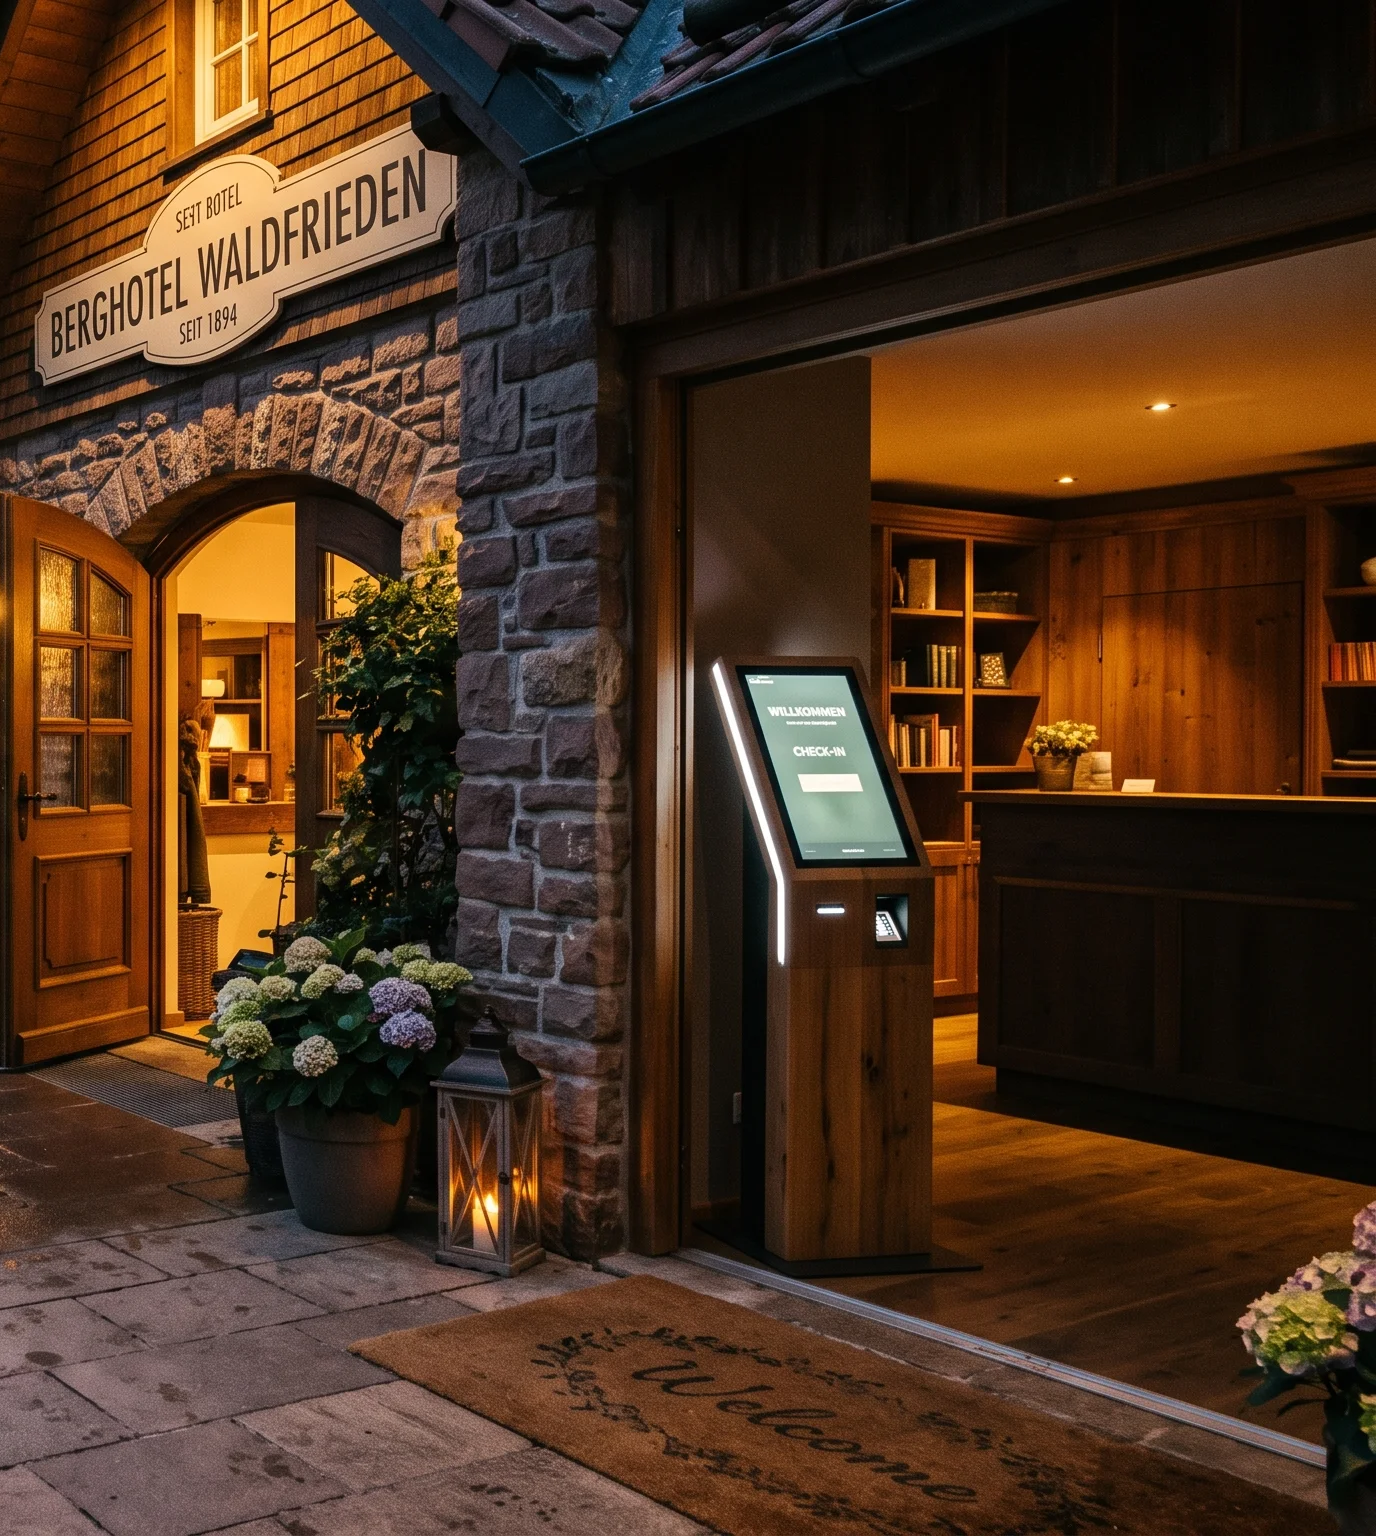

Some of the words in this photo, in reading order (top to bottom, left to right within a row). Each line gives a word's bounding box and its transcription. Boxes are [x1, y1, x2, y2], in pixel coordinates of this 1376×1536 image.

[206, 182, 242, 220] BOTEL
[51, 256, 189, 359] BERGHOTEL
[197, 148, 426, 299] WALDFRIEDEN
[179, 315, 203, 345] SEIT
[208, 302, 238, 335] 1894
[767, 706, 846, 717] WILLKOMMEN
[793, 746, 846, 757] CHECK-IN
[631, 1359, 977, 1501] Welcome
